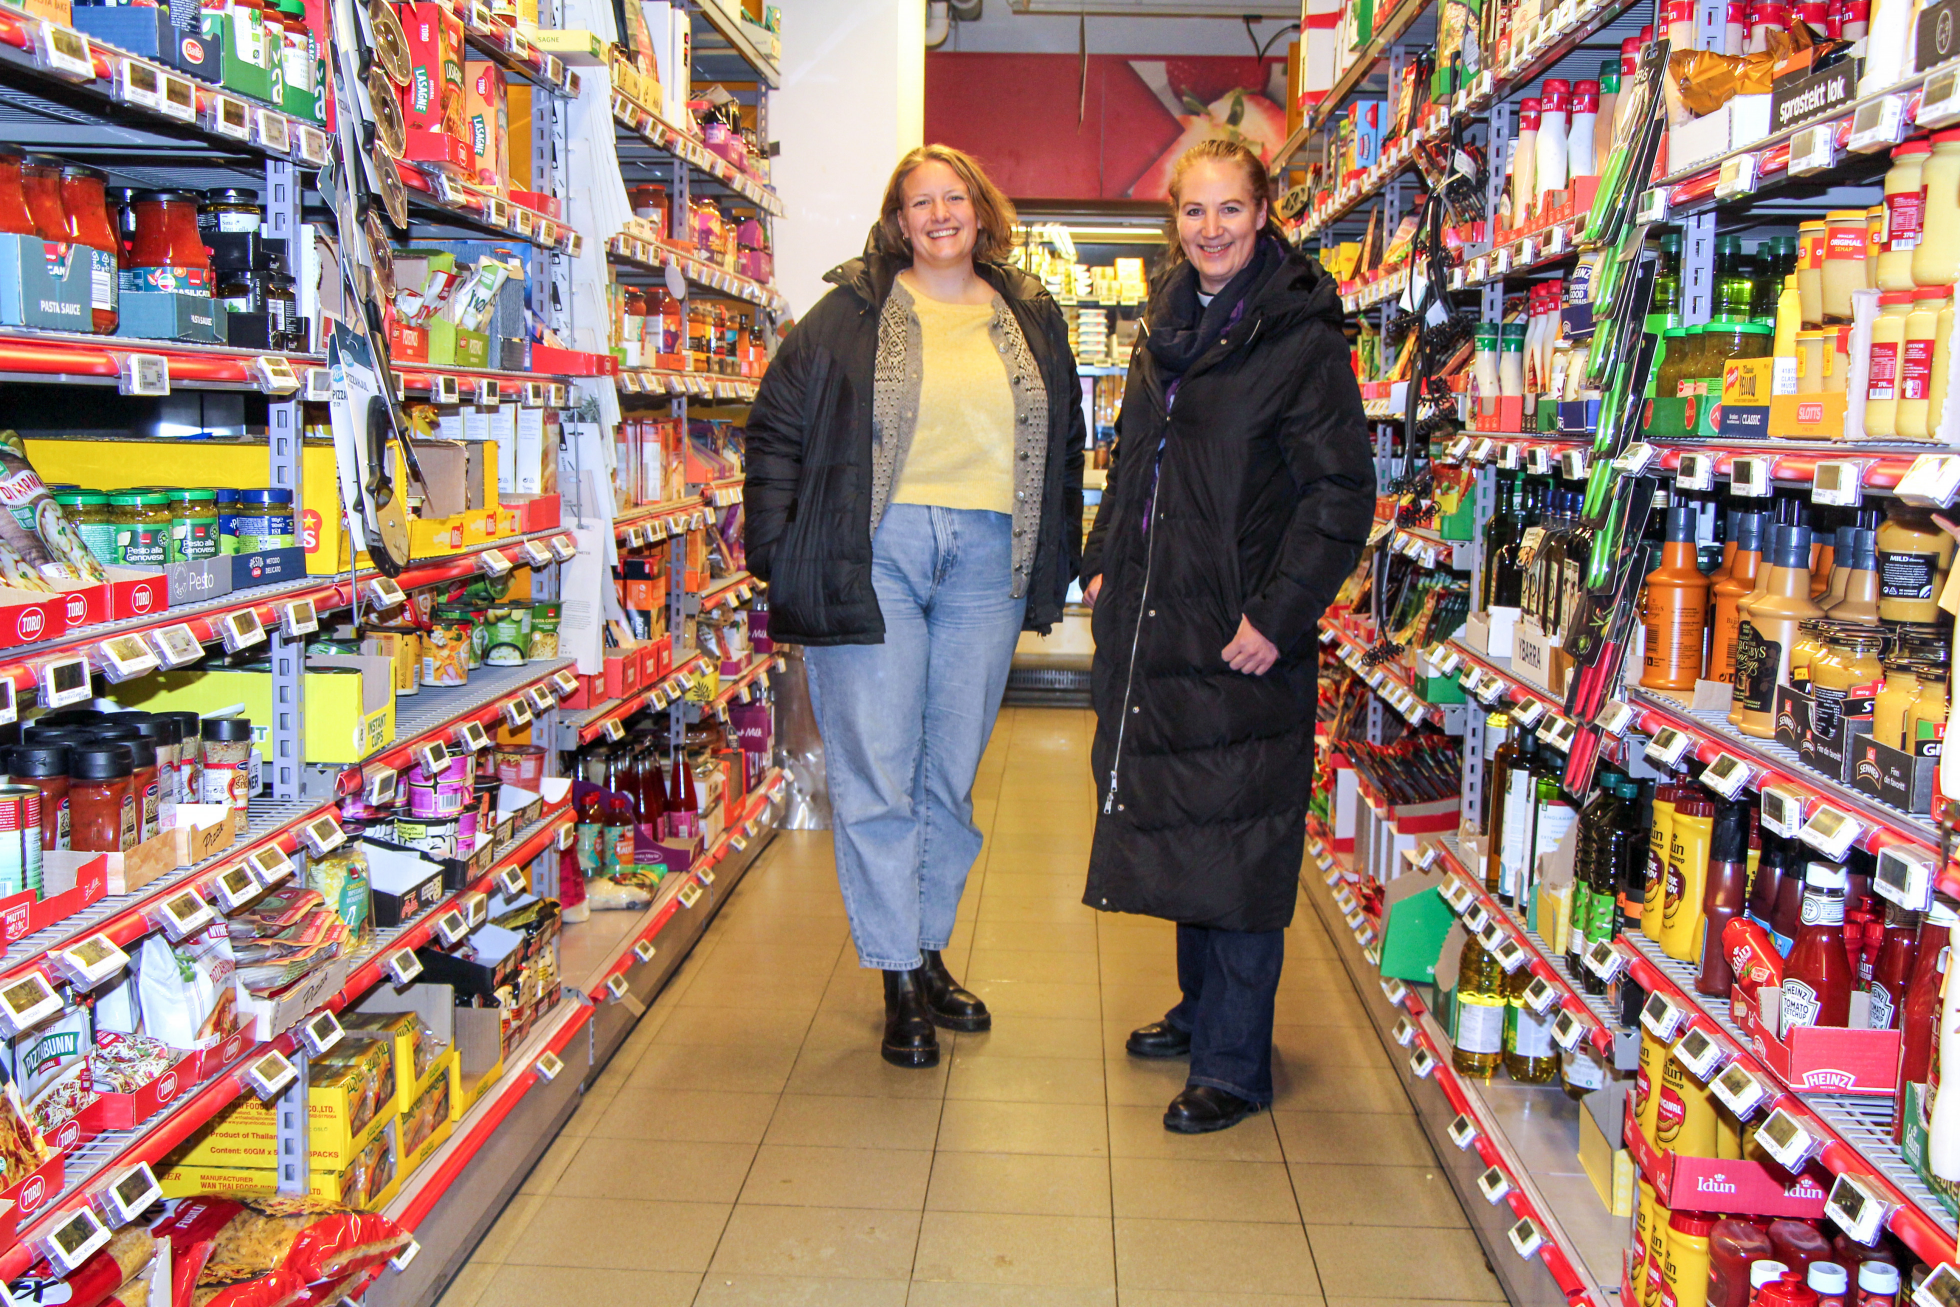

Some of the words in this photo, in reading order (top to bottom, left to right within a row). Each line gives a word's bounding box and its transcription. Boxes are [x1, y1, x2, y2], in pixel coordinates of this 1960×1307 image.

[420, 23, 430, 42] TORO
[414, 69, 426, 112] LASAGNE
[477, 79, 486, 95] TORO
[1779, 86, 1826, 122] sprøstekt
[1827, 76, 1846, 103] løk
[473, 118, 484, 154] LASAGNE
[1830, 239, 1863, 247] ORIGINAL
[47, 266, 65, 276] CAN
[40, 300, 60, 313] PASTA
[61, 303, 81, 315] SAUCE
[332, 390, 348, 401] PIZZA
[1742, 415, 1761, 425] CLASSIC
[1798, 407, 1822, 420] SLOTTS
[1, 483, 17, 500] DI
[127, 546, 151, 555] Pesto
[151, 546, 163, 554] alla
[182, 546, 215, 554] Genovese
[183, 539, 203, 547] Pesto
[204, 539, 215, 547] alla
[126, 553, 164, 561] Genovese
[265, 565, 282, 575] DELICATO
[189, 571, 214, 592] Pesto
[134, 591, 150, 607] TORO
[66, 601, 84, 617] TORO
[22, 615, 41, 633] TORO
[1519, 637, 1541, 670] YBARRA
[367, 713, 386, 737] INSTANT
[1778, 715, 1795, 731] SENNEP
[371, 731, 384, 749] CUPS
[745, 728, 763, 738] Milk
[1802, 741, 1815, 753] SENNEP
[1859, 763, 1879, 780] SENNEP
[1890, 766, 1900, 777] Finn
[1883, 775, 1891, 784] din
[1890, 777, 1906, 791] favoritt
[203, 823, 225, 855] Pizza
[1651, 829, 1663, 842] un
[1670, 842, 1685, 856] un
[346, 880, 366, 891] CHICKEN
[6, 908, 26, 925] MUTTI
[1803, 907, 1813, 917] 57
[1786, 986, 1807, 1001] HEINZ
[1784, 997, 1809, 1014] TOMATO
[1784, 1007, 1807, 1020] KETCHUP
[1748, 1010, 1756, 1029] Id
[25, 1034, 74, 1074] PIZZABUNN
[1664, 1061, 1683, 1081] dun
[160, 1077, 175, 1096] TORO
[1808, 1073, 1850, 1089] HEINZ
[245, 1103, 270, 1111] FOODS
[60, 1129, 77, 1147] TORO
[210, 1131, 240, 1140] Product
[241, 1132, 249, 1140] of
[251, 1132, 278, 1140] Thailan
[210, 1146, 242, 1155] Content:
[243, 1147, 266, 1156] 60GM
[200, 1174, 253, 1183] MANUFACTURER
[218, 1182, 235, 1190] THAI
[1697, 1176, 1736, 1193] Idun
[22, 1183, 42, 1202] TORO
[1784, 1182, 1822, 1200] Idun
[176, 1204, 208, 1229] FUSILLI
